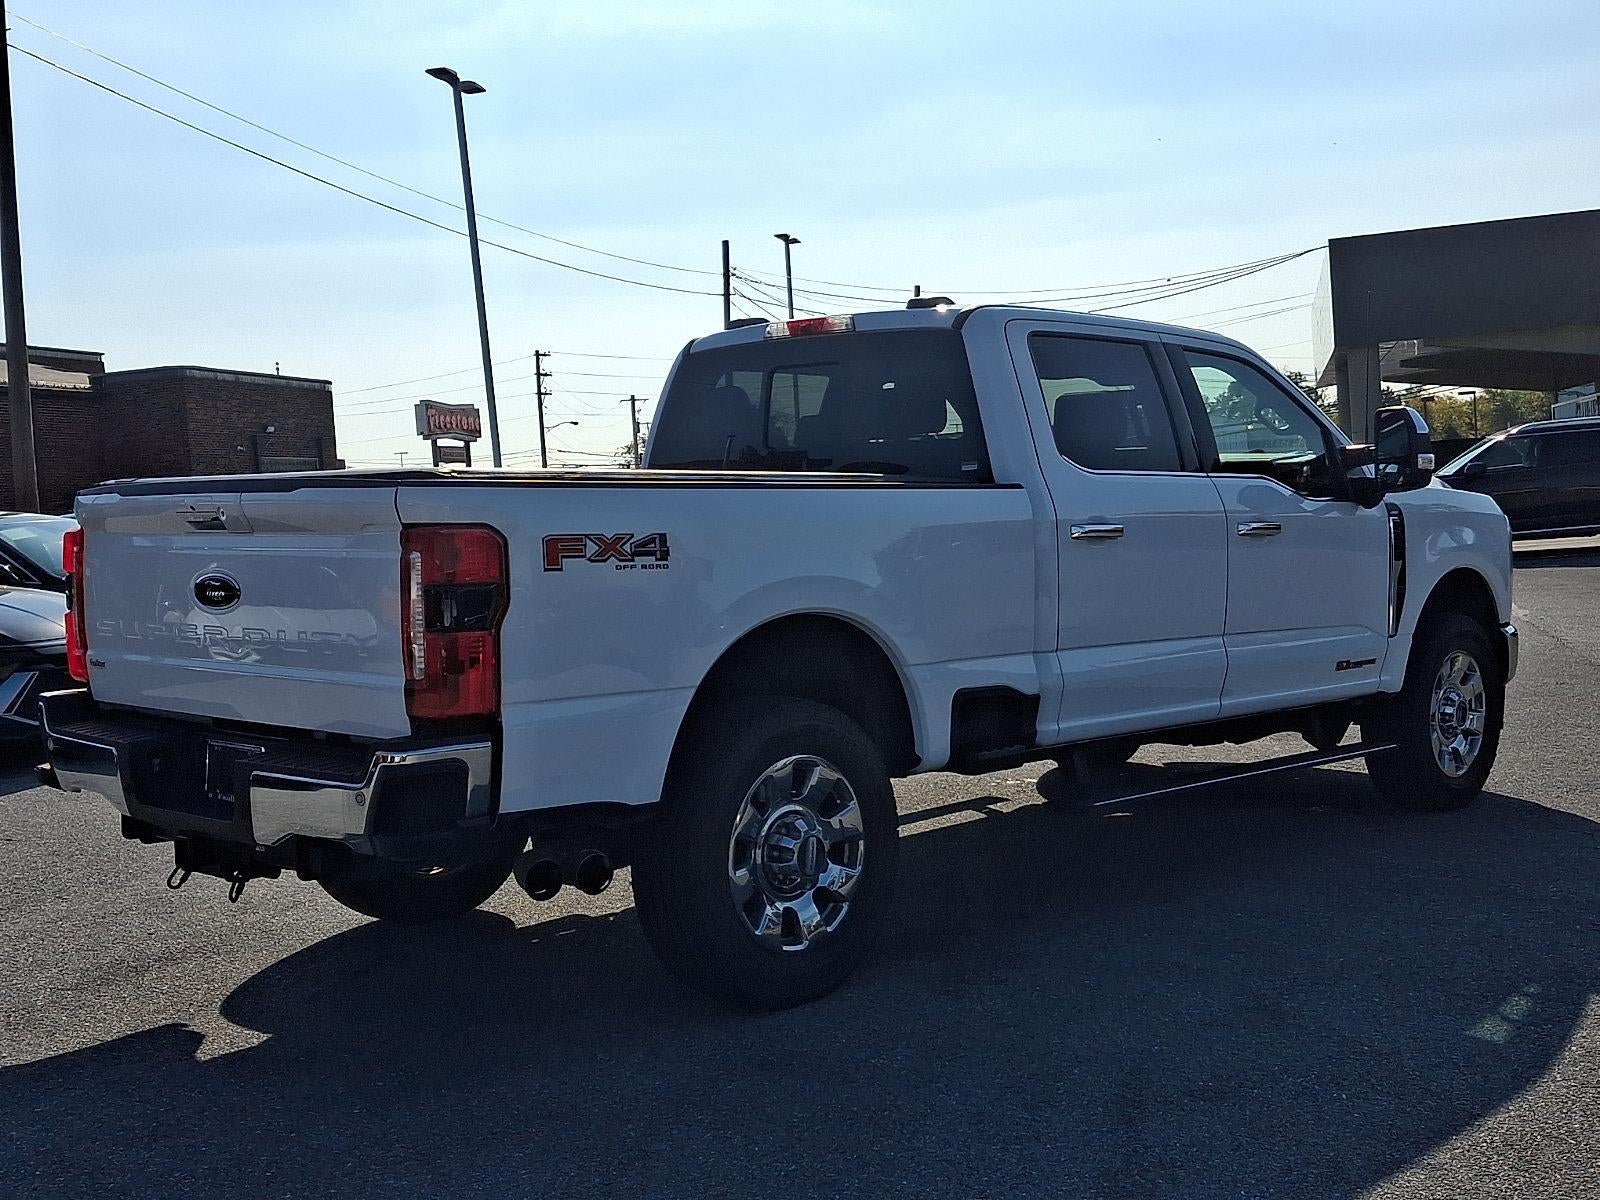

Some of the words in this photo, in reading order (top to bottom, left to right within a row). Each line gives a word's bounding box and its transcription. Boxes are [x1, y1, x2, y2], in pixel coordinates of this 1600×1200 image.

[427, 407, 481, 432] Firestone
[542, 533, 670, 572] FX4
[615, 563, 637, 571] OFF
